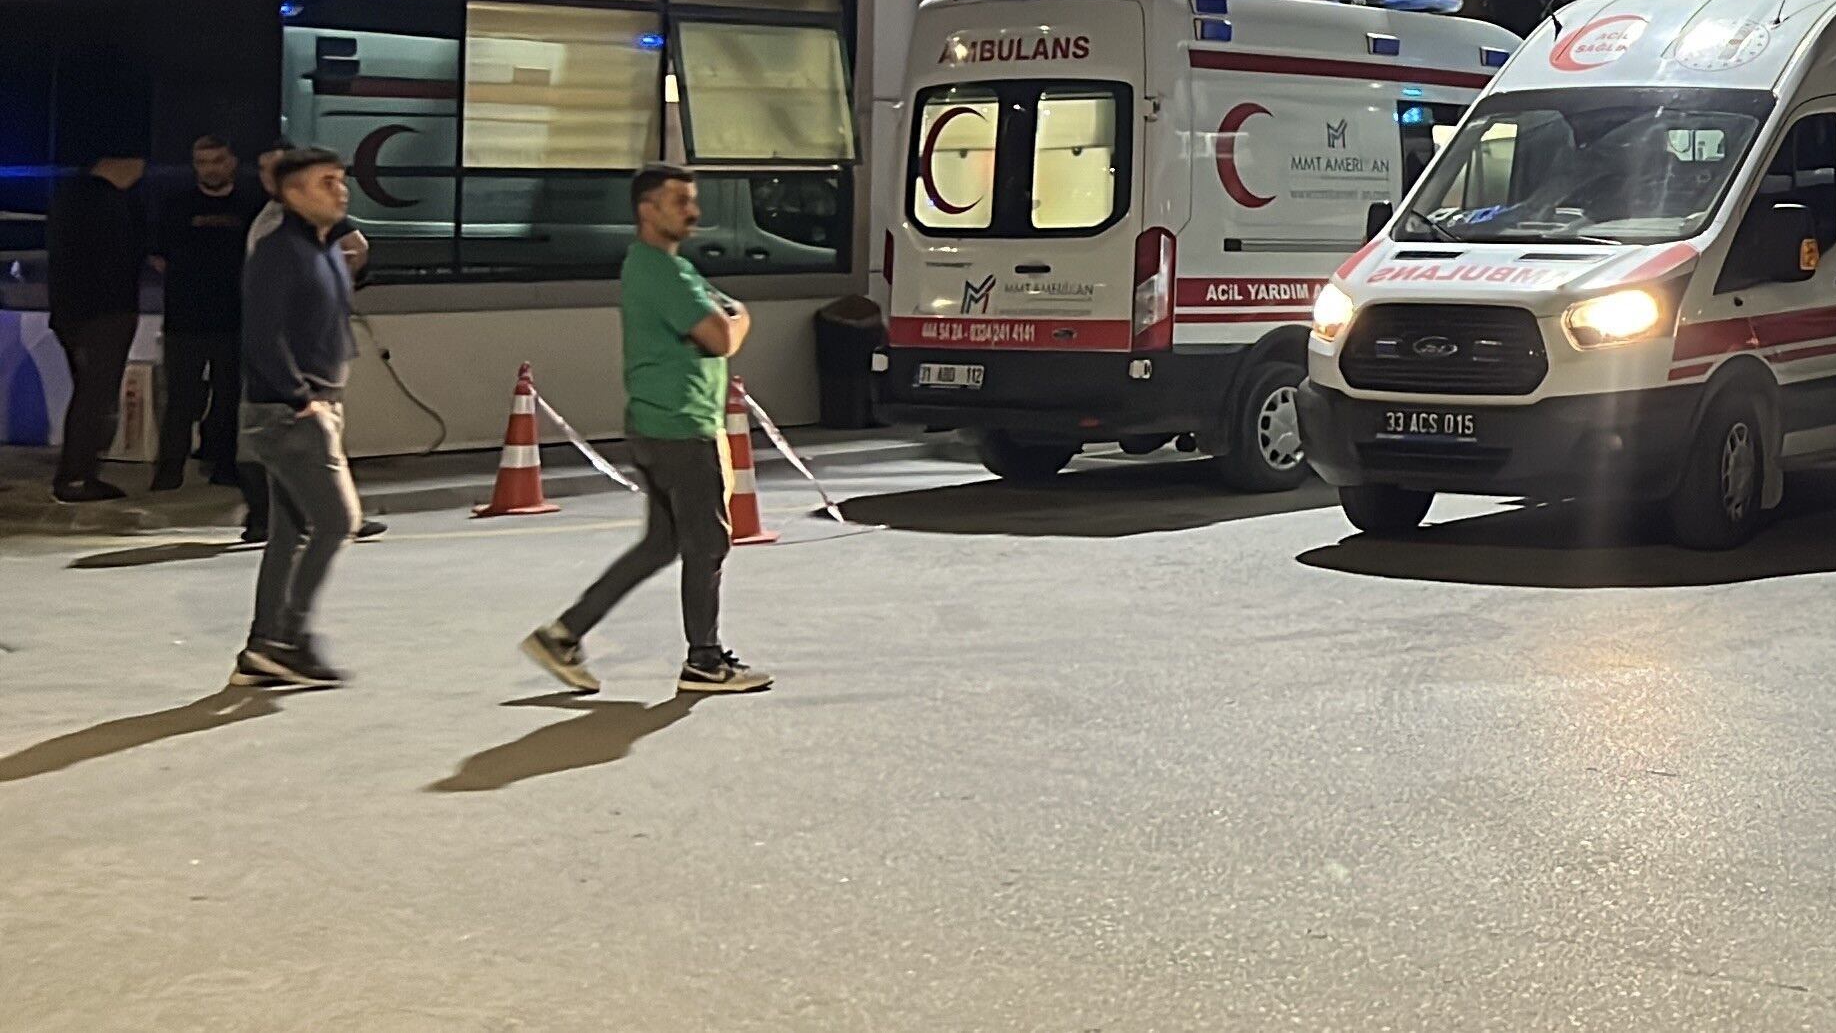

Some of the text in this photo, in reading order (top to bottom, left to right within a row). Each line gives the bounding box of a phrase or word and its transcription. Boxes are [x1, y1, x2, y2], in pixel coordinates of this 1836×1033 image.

[1246, 283, 1310, 301] YARDIM
[1386, 412, 1474, 434] 33 ACS 015
